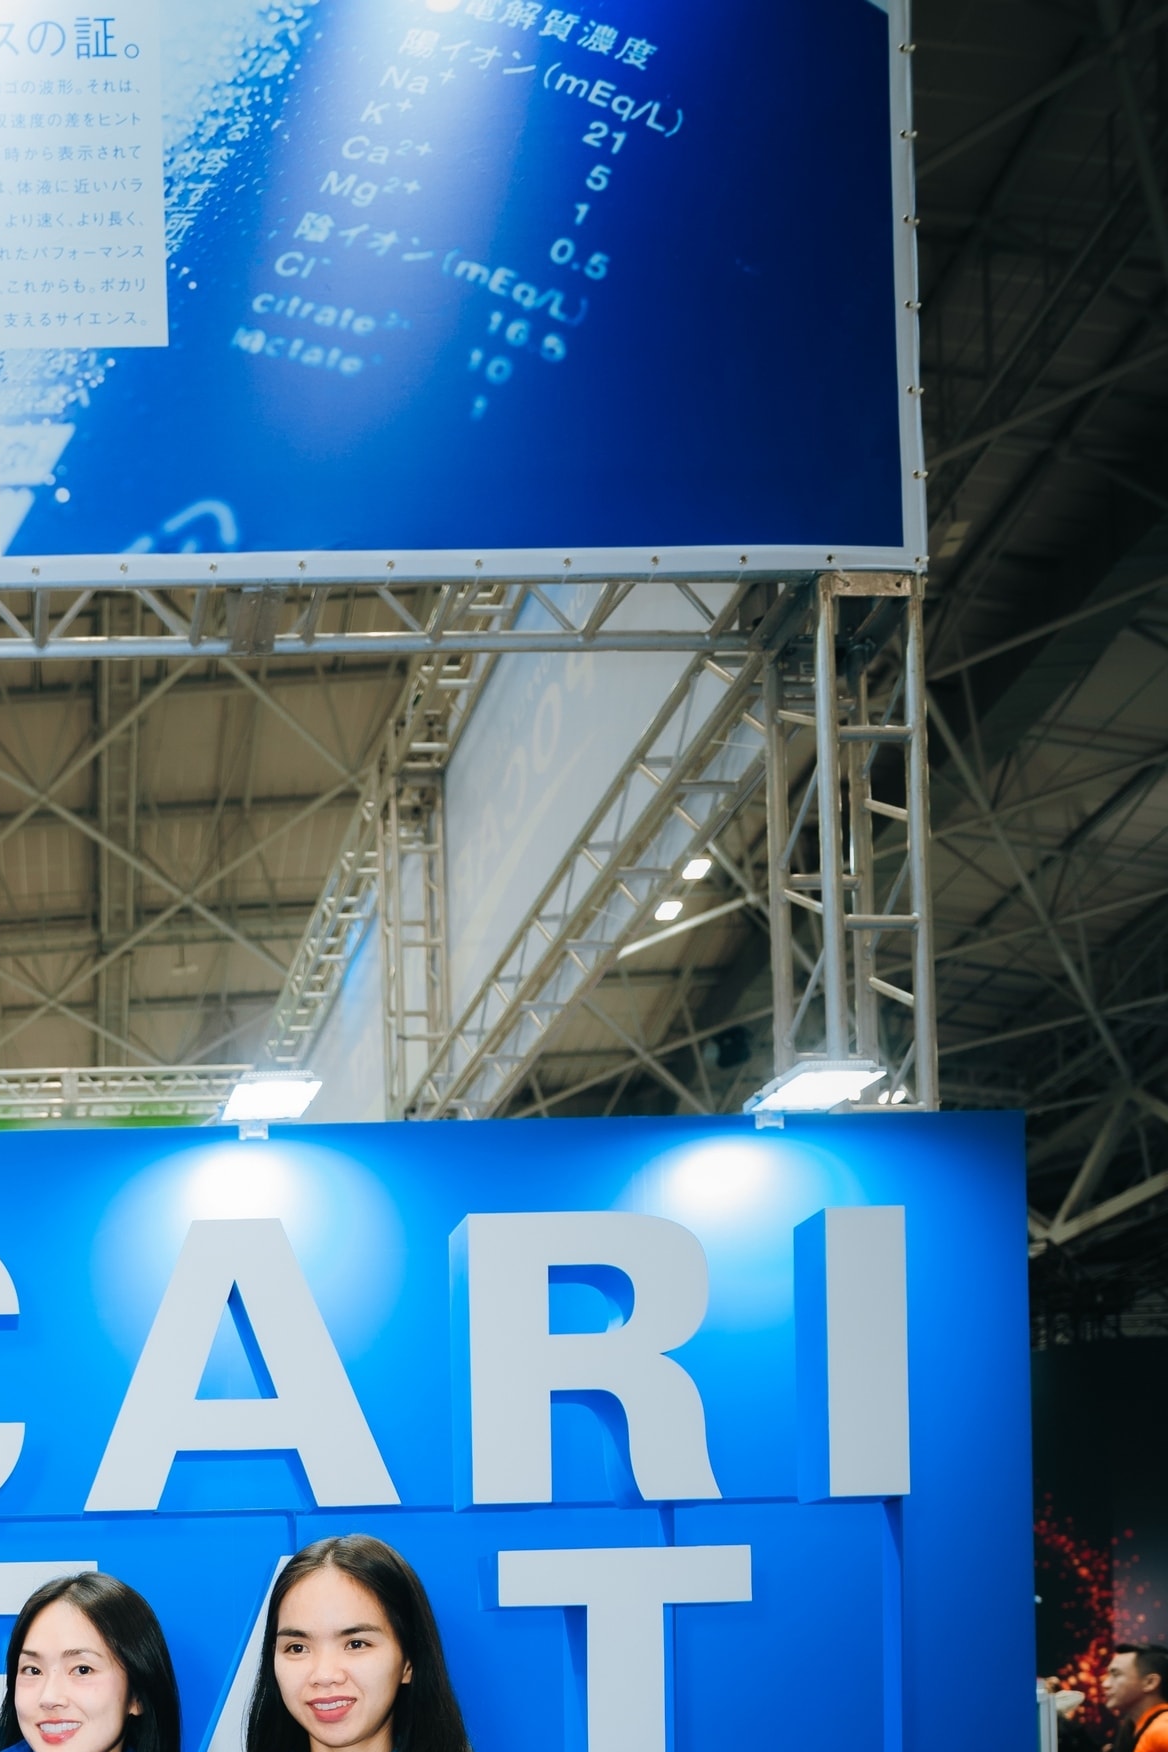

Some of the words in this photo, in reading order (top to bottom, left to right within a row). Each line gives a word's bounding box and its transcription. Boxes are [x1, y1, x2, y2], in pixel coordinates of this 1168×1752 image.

[582, 121, 627, 155] 21
[586, 165, 612, 191] 5
[573, 203, 590, 225] 1
[550, 237, 609, 281] 0.5
